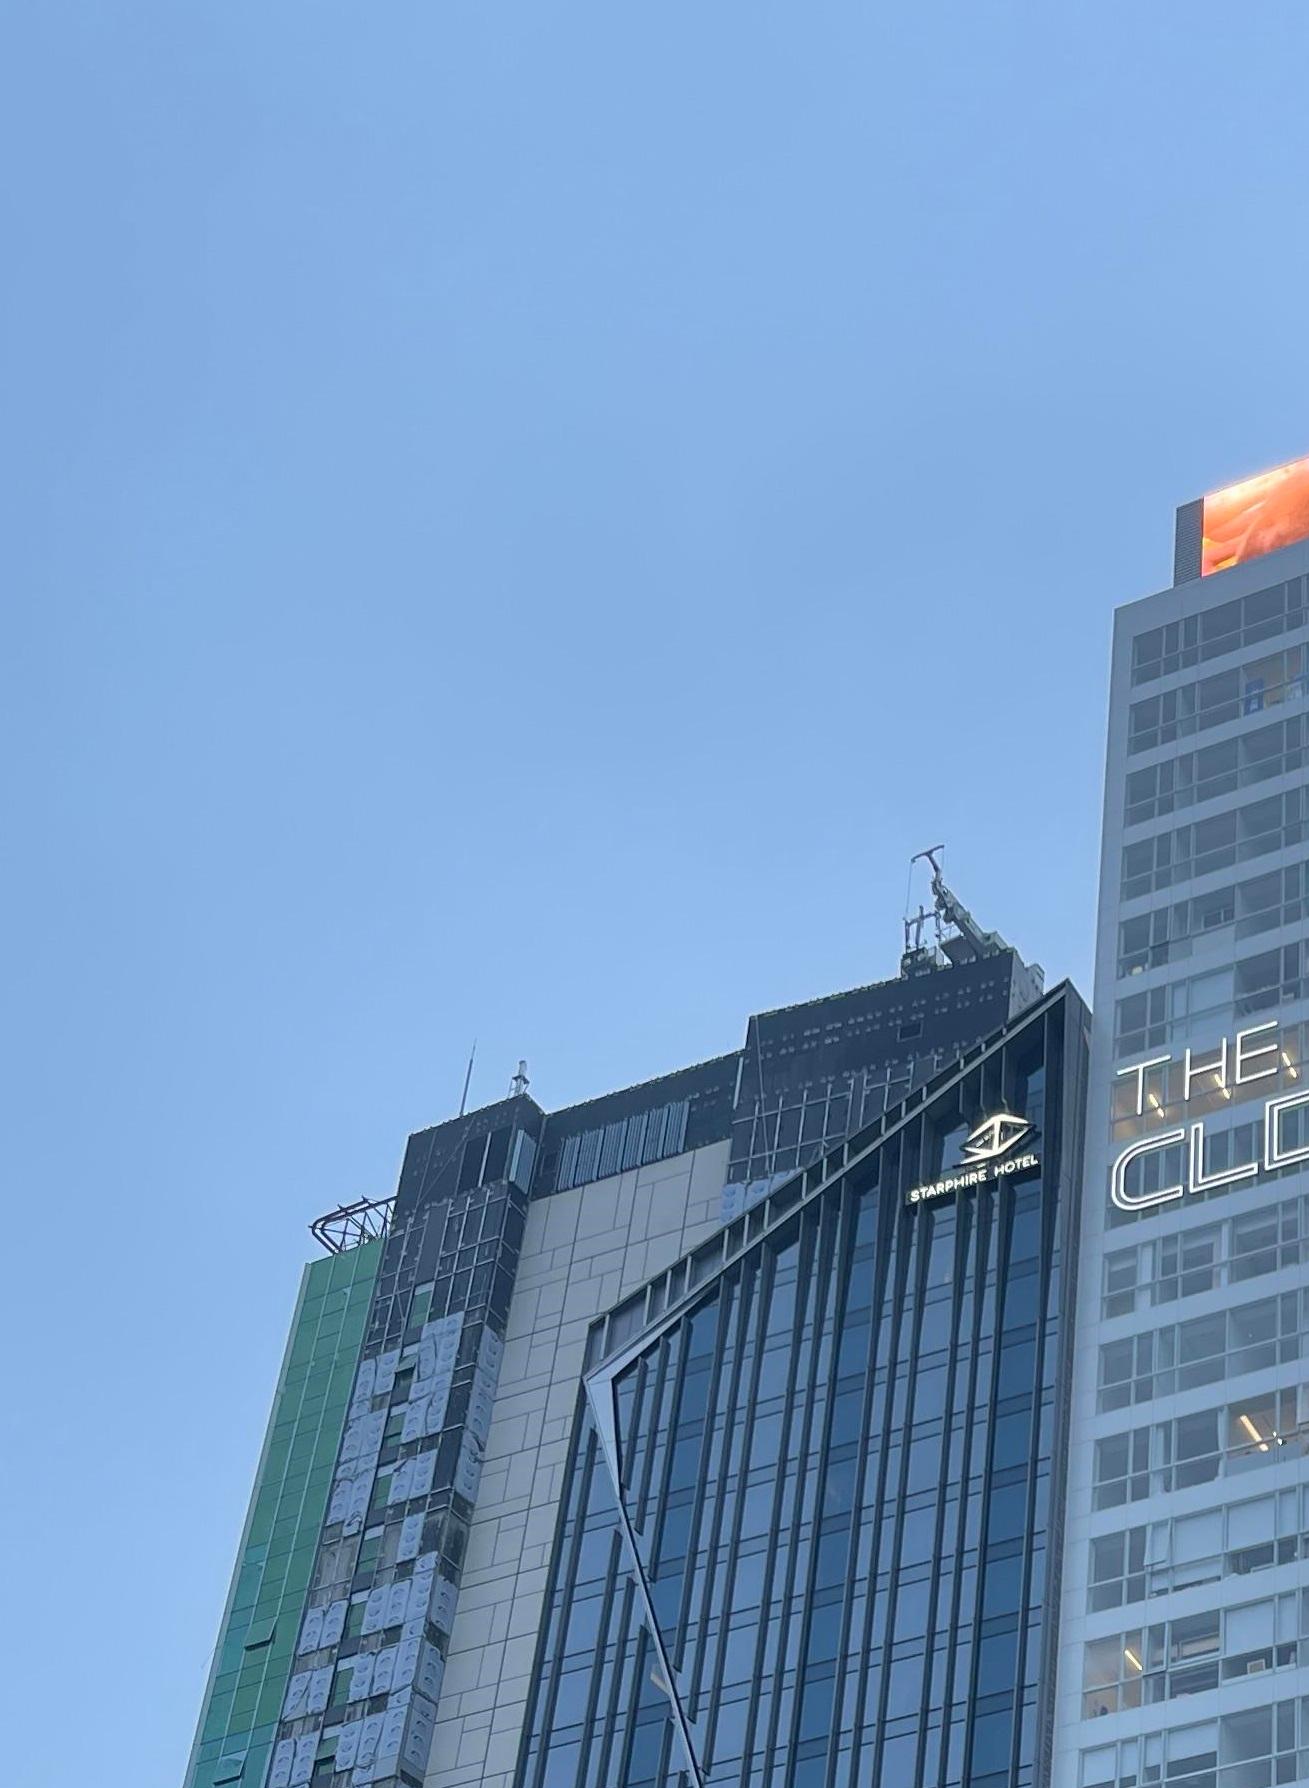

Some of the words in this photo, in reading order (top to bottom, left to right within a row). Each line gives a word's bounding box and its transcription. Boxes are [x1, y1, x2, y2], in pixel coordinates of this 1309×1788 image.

[1116, 1021, 1279, 1117] THE
[909, 1169, 988, 1203] STARPHIRE
[994, 1154, 1039, 1178] HOTEL
